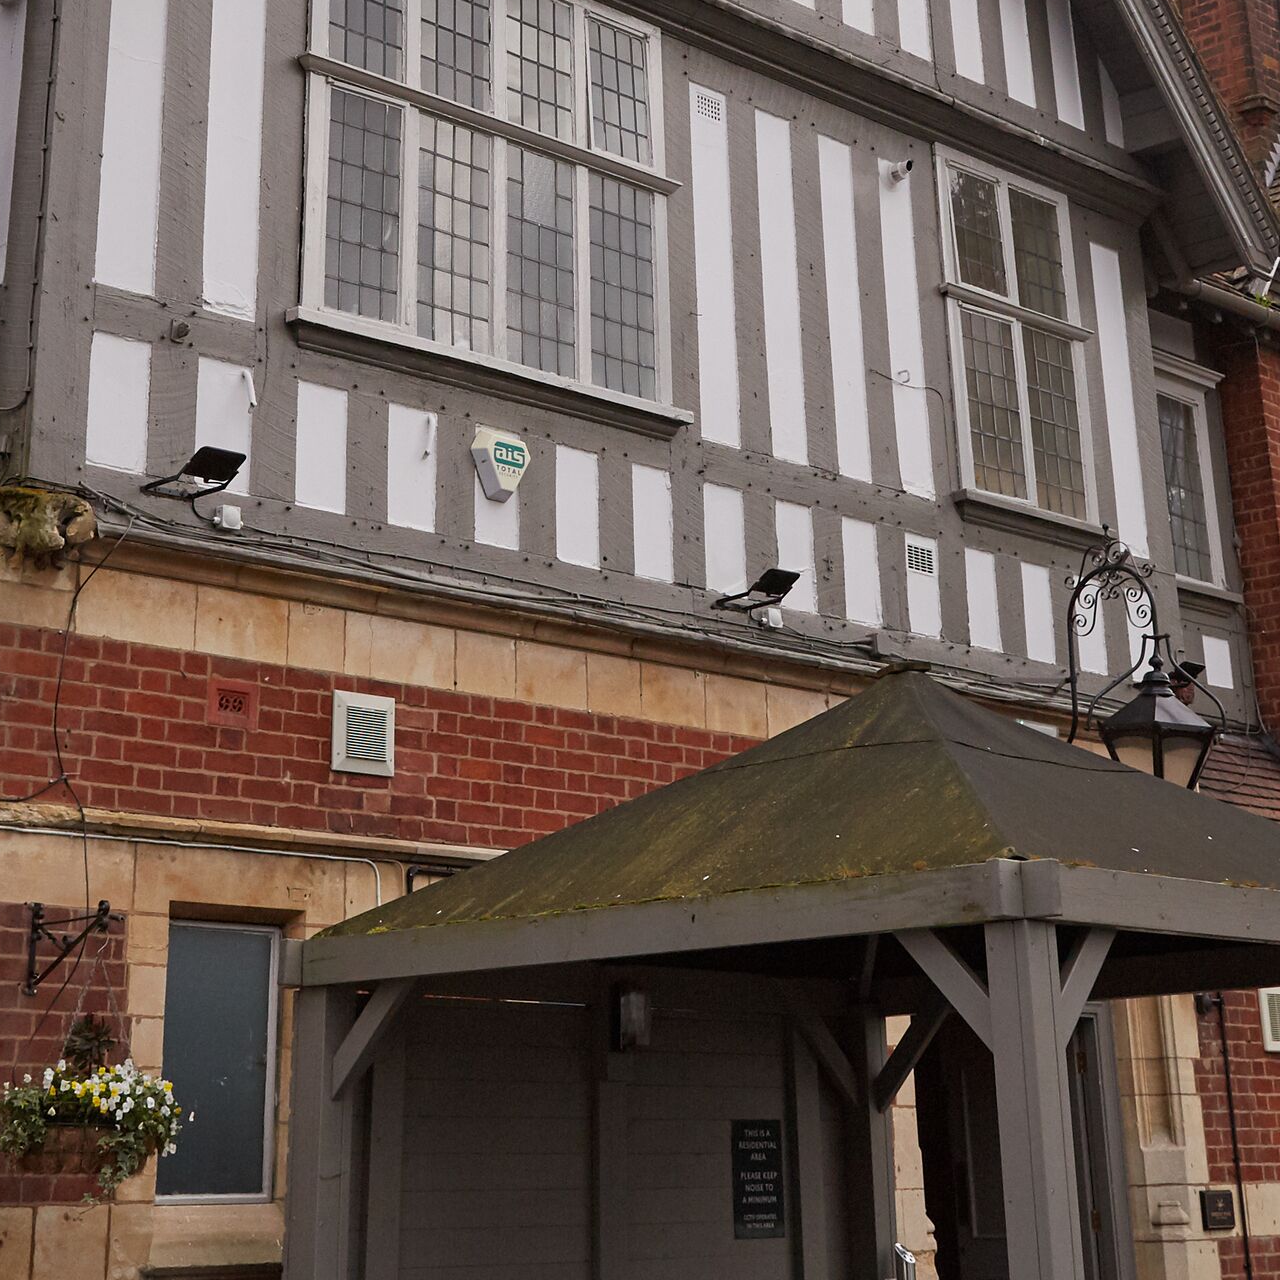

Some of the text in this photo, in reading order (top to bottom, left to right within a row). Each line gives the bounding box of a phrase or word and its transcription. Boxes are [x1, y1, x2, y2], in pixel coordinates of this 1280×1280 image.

[496, 464, 521, 475] TOTAL
[744, 1129, 758, 1137] THIS
[766, 1129, 771, 1137] A
[738, 1141, 777, 1150] RESIDENTIAL
[750, 1152, 767, 1161] AREA
[740, 1171, 778, 1180] PLEASE KEEP
[745, 1183, 774, 1192] NOISE TO
[742, 1195, 777, 1204] A MINIMUM
